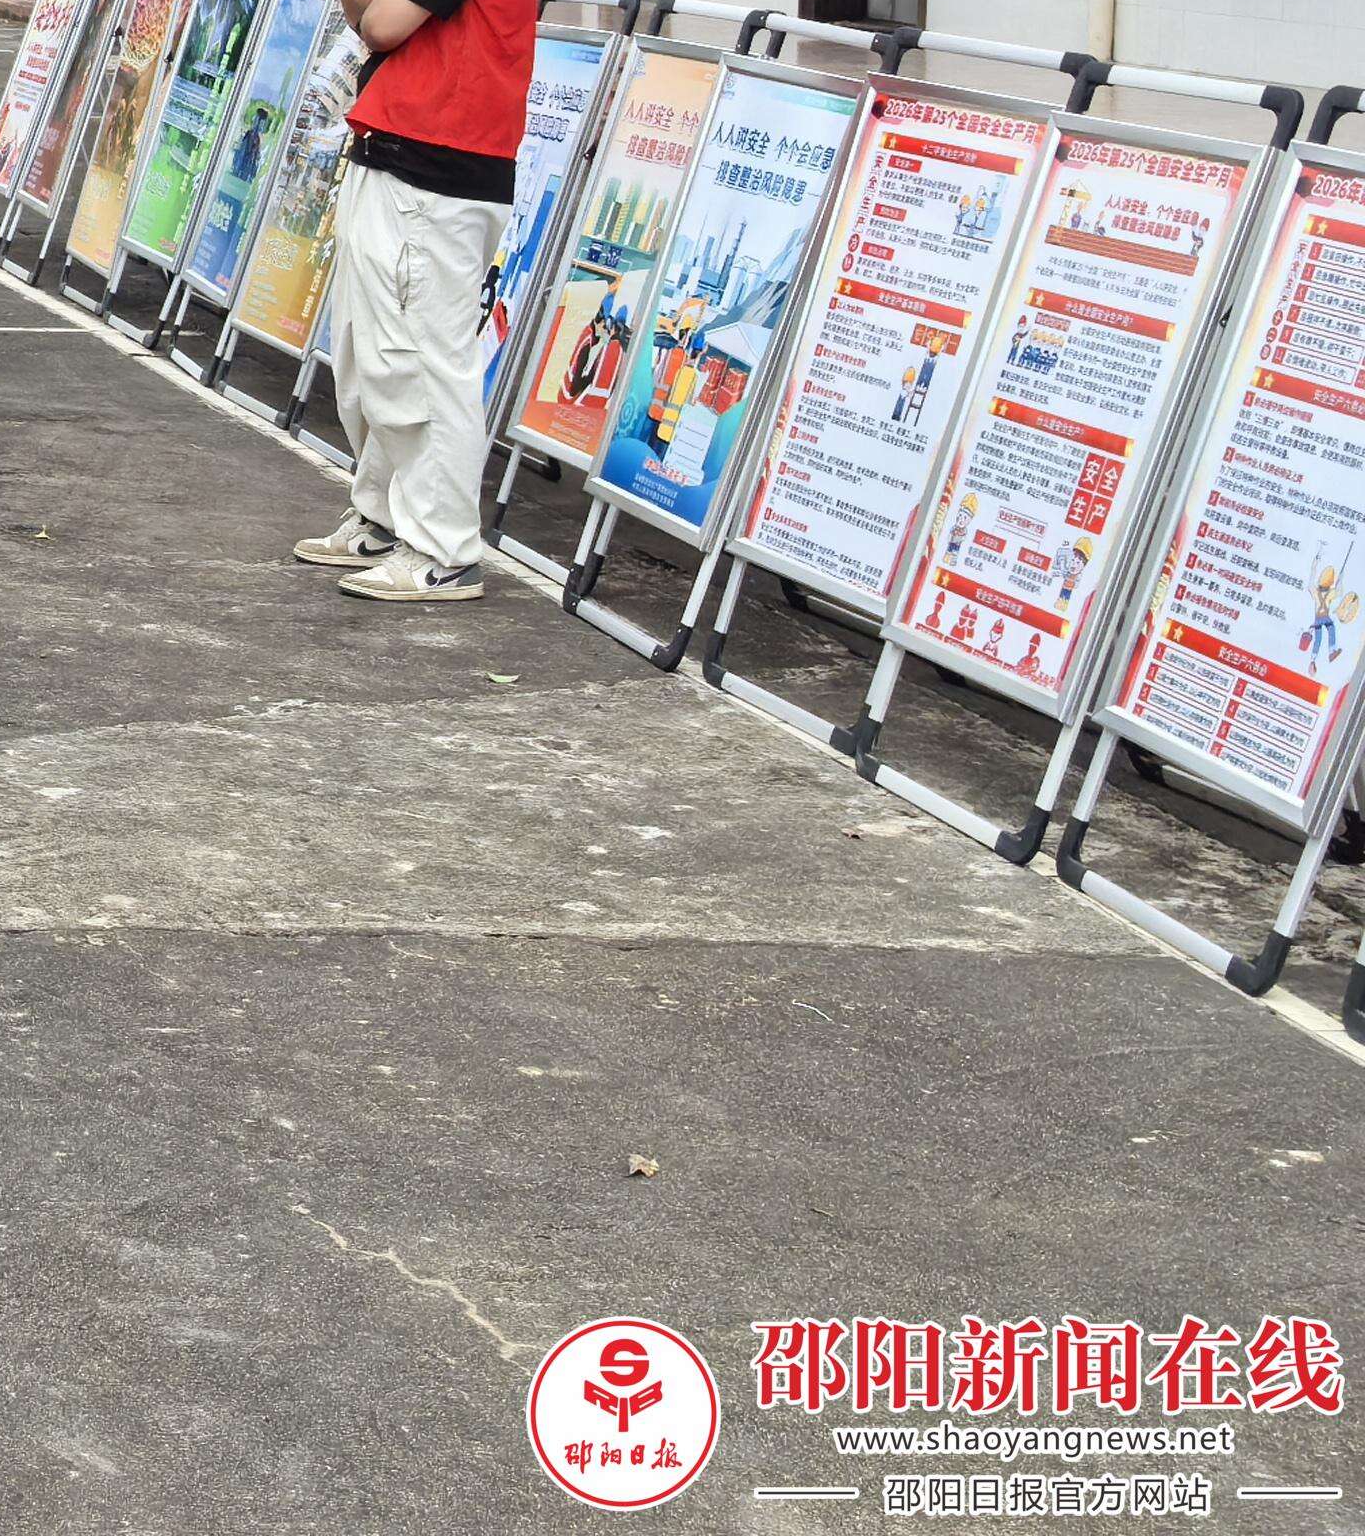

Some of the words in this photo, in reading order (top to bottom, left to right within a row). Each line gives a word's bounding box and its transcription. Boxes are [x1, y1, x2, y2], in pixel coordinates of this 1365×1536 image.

[712, 121, 771, 155] 人人讲安全
[776, 135, 836, 171] 个个会应急
[1069, 142, 1232, 188] 2026年第25个全国安全生产月
[716, 160, 808, 203] 排查整治风险隐患
[1313, 175, 1365, 206] 2026年
